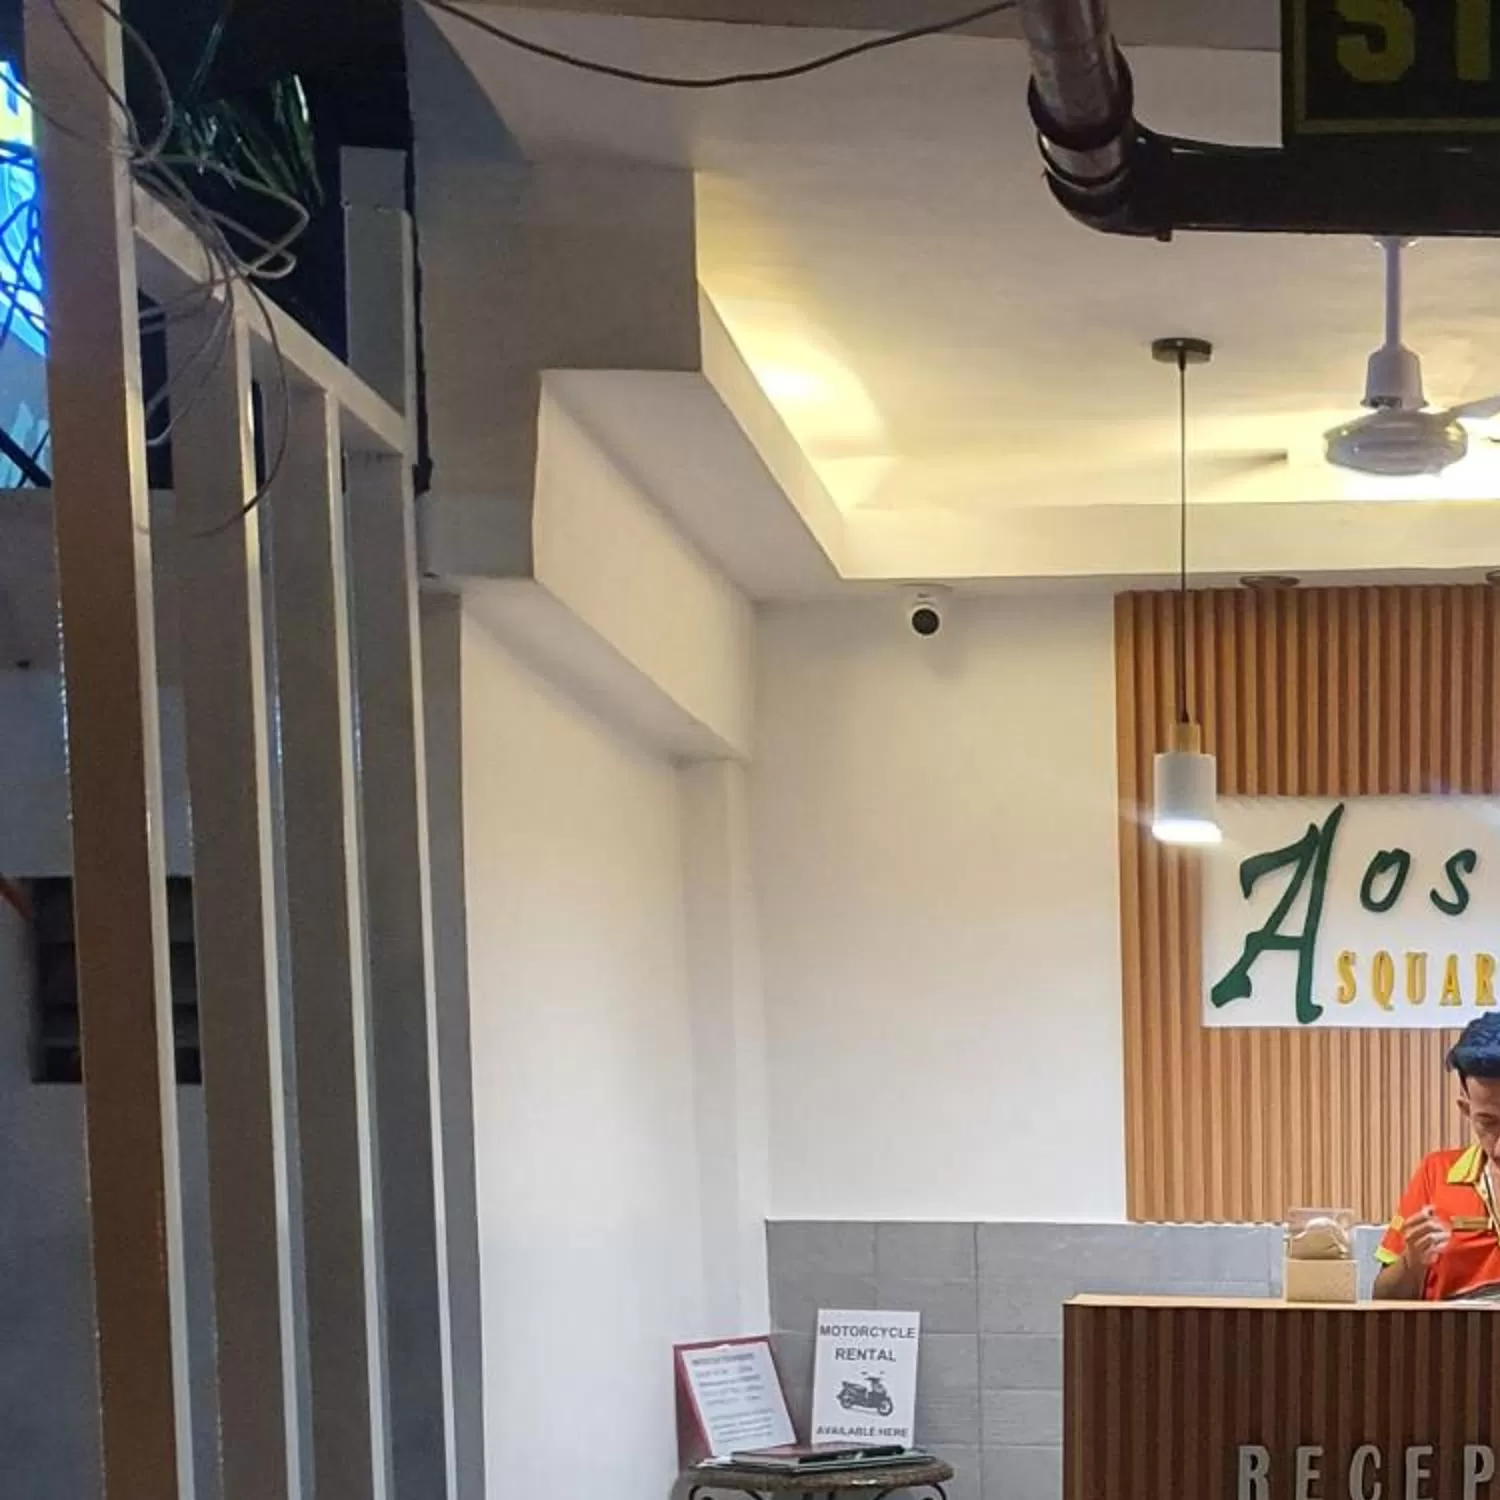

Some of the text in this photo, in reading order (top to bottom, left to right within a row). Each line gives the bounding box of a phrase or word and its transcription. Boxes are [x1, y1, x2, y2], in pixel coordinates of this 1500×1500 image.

[819, 1324, 916, 1339] MOTORCYCLE
[835, 1347, 896, 1362] RENTAL
[816, 1425, 909, 1438] AVAILABLE HERE
